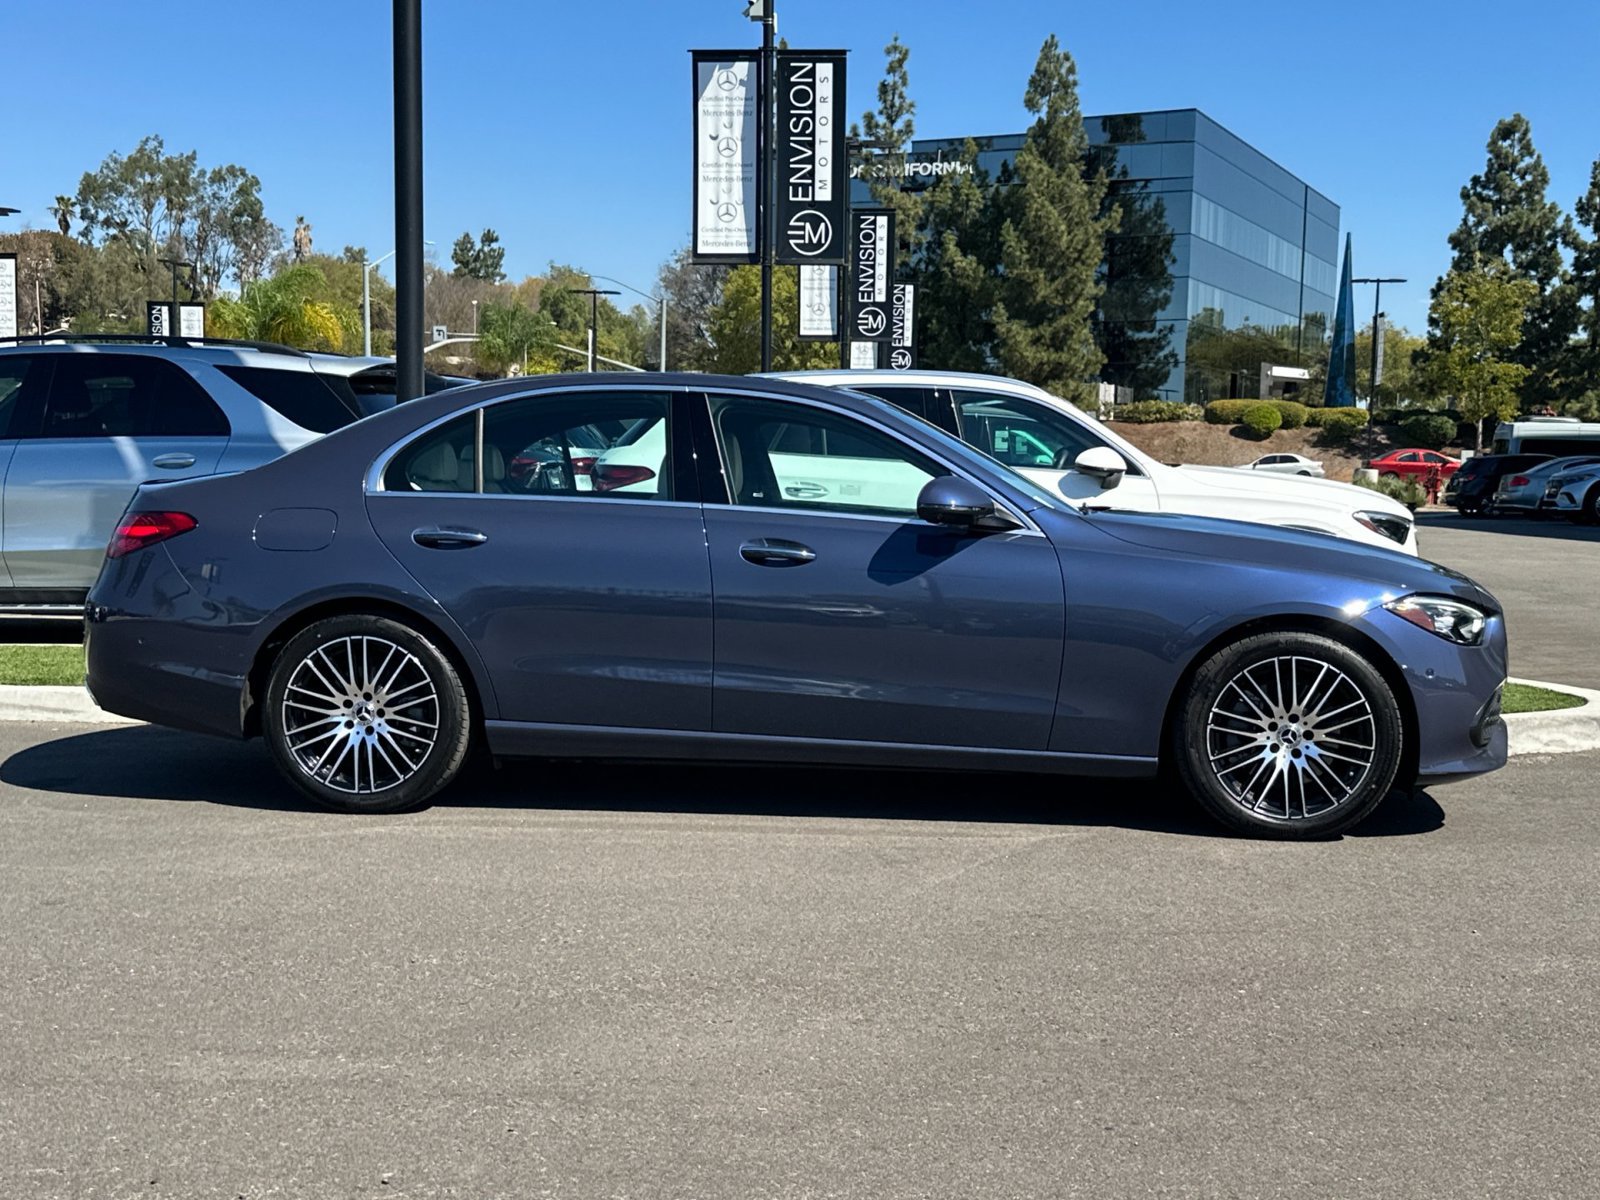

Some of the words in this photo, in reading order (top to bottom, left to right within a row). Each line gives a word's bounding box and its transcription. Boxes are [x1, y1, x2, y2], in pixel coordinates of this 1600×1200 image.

[789, 62, 813, 201] ENVISION
[818, 76, 829, 190] MOTORS
[858, 215, 875, 302] ENVISION
[878, 224, 886, 295] MOTORS
[891, 284, 905, 347] ENVISION
